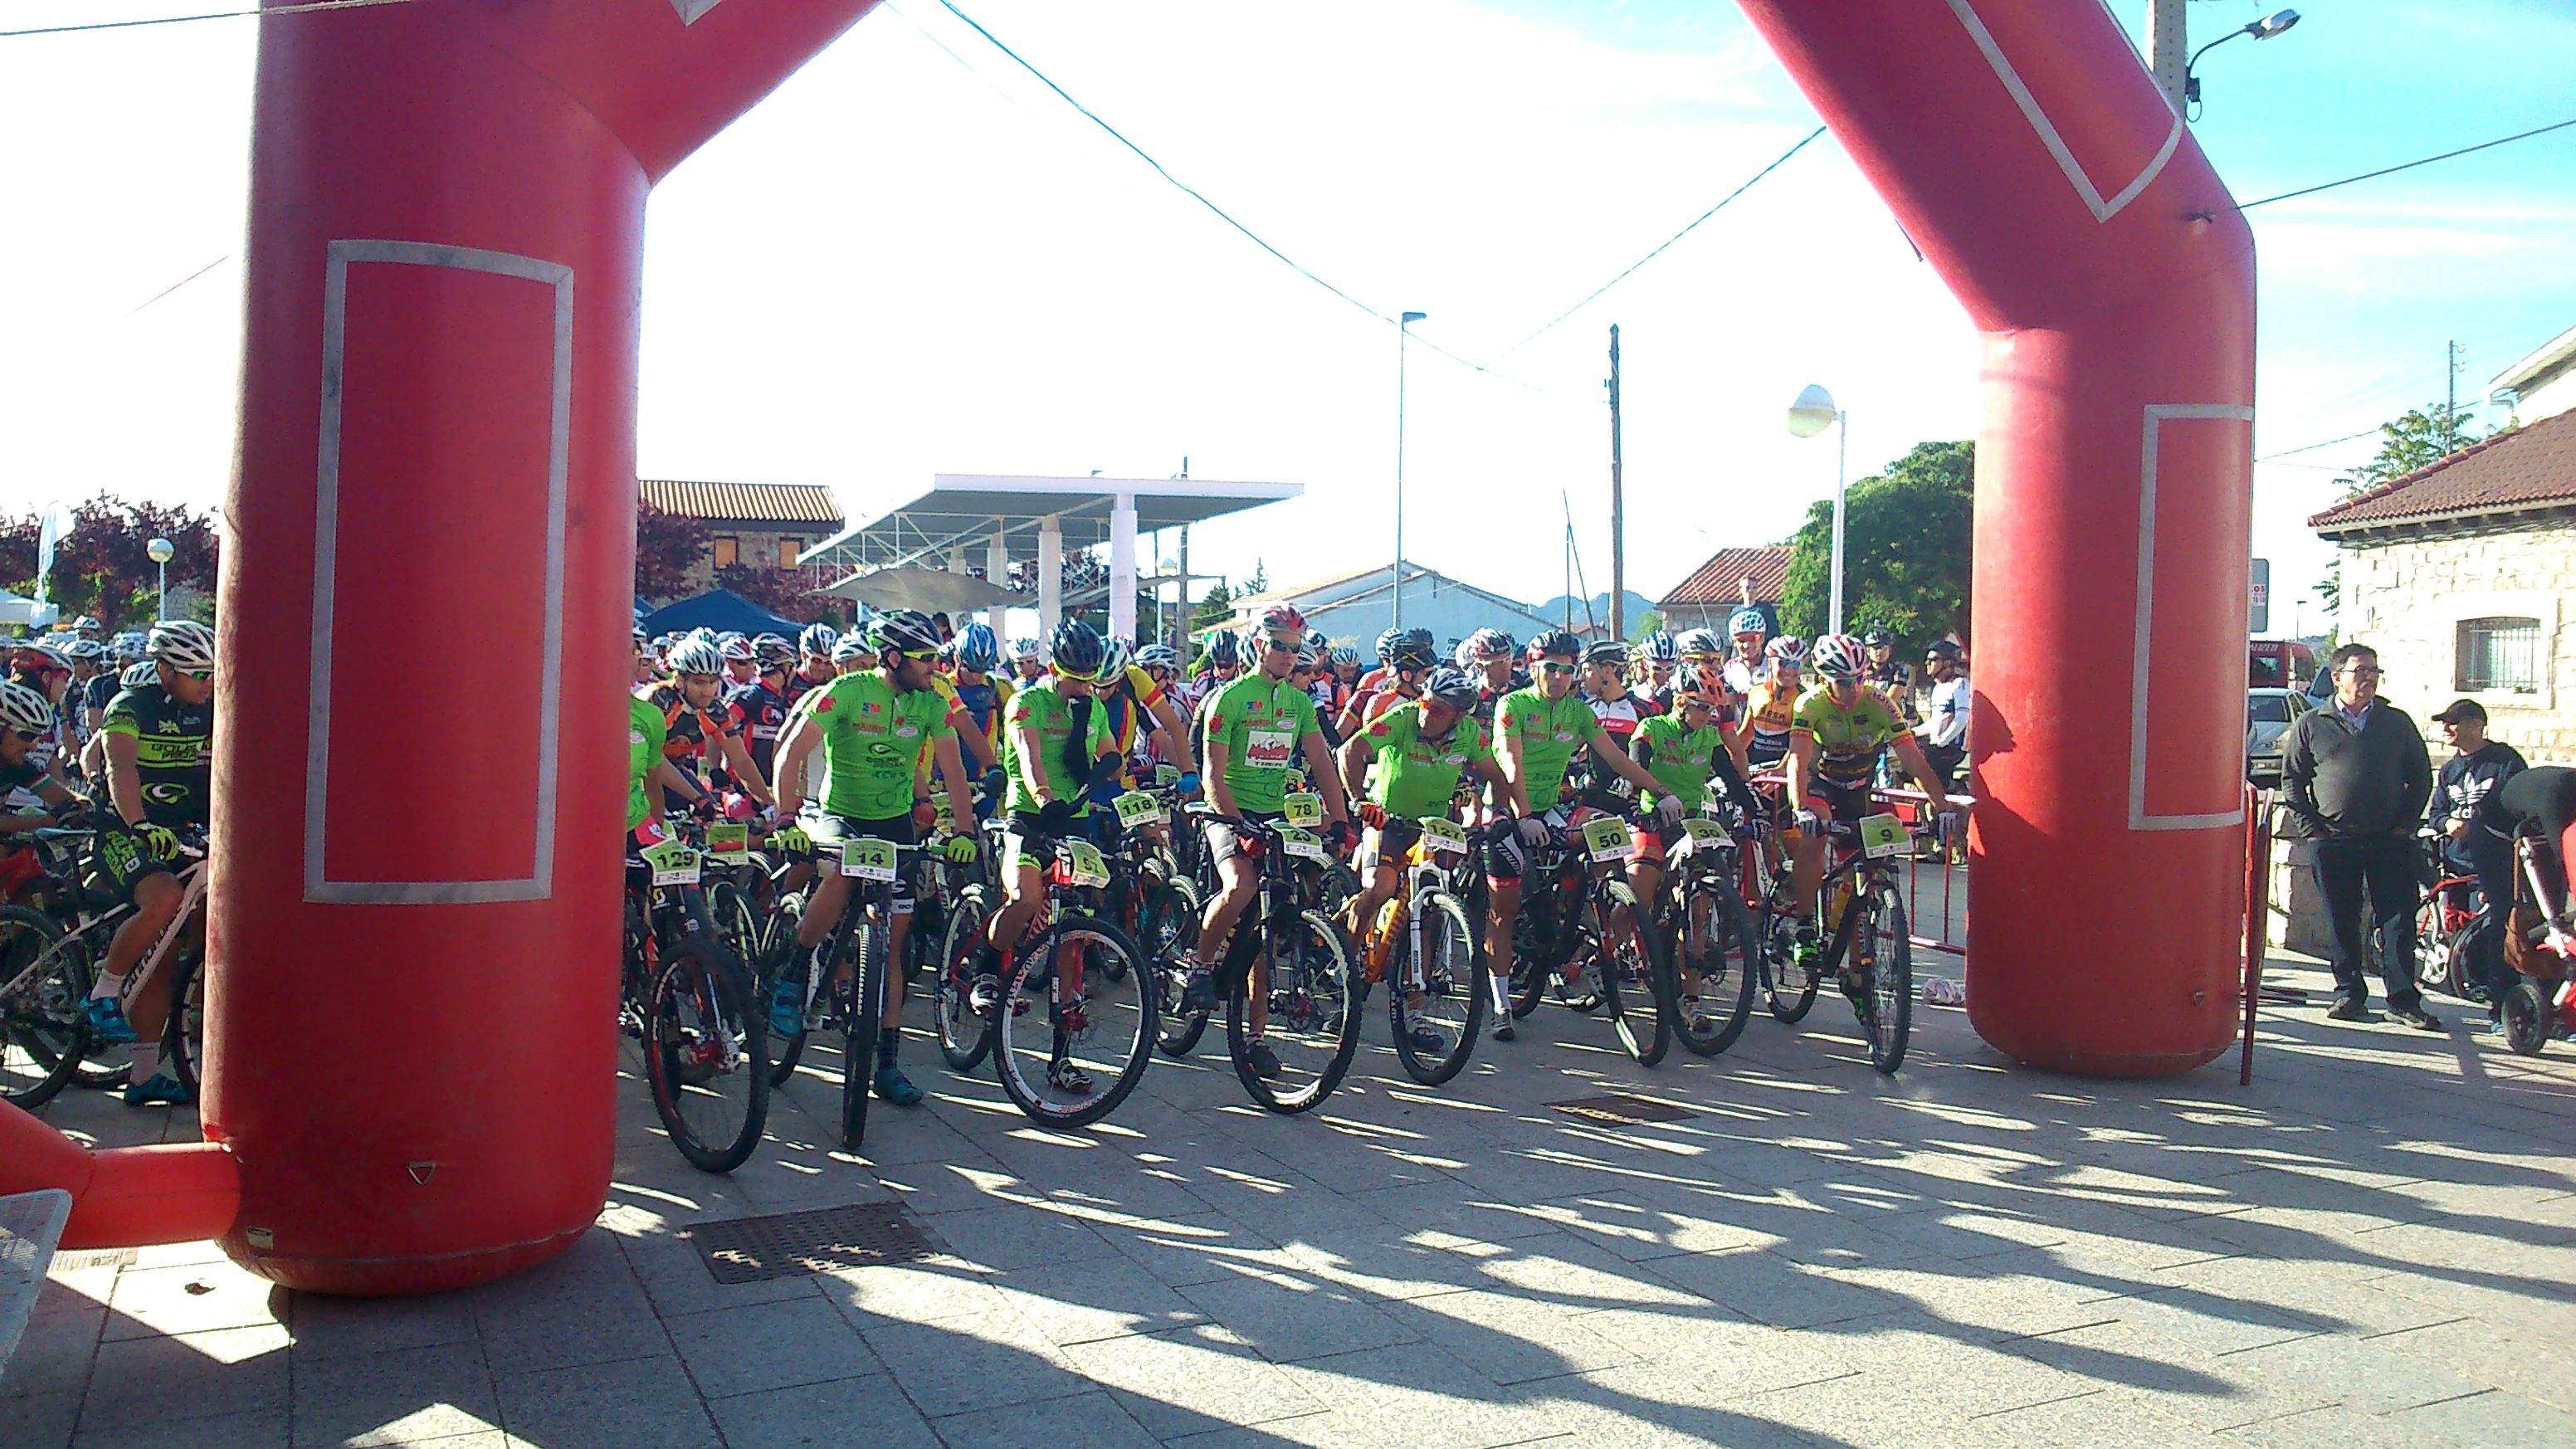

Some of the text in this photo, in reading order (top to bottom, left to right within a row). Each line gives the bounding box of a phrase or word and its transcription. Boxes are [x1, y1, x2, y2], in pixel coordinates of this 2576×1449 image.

[1122, 799, 1153, 815] 118
[1293, 803, 1312, 817] 78
[1430, 824, 1460, 839] 127
[1698, 829, 1720, 837] 30
[1880, 828, 1893, 842] 9
[1598, 832, 1622, 848] 50
[656, 851, 695, 867] 129
[857, 852, 885, 865] 14
